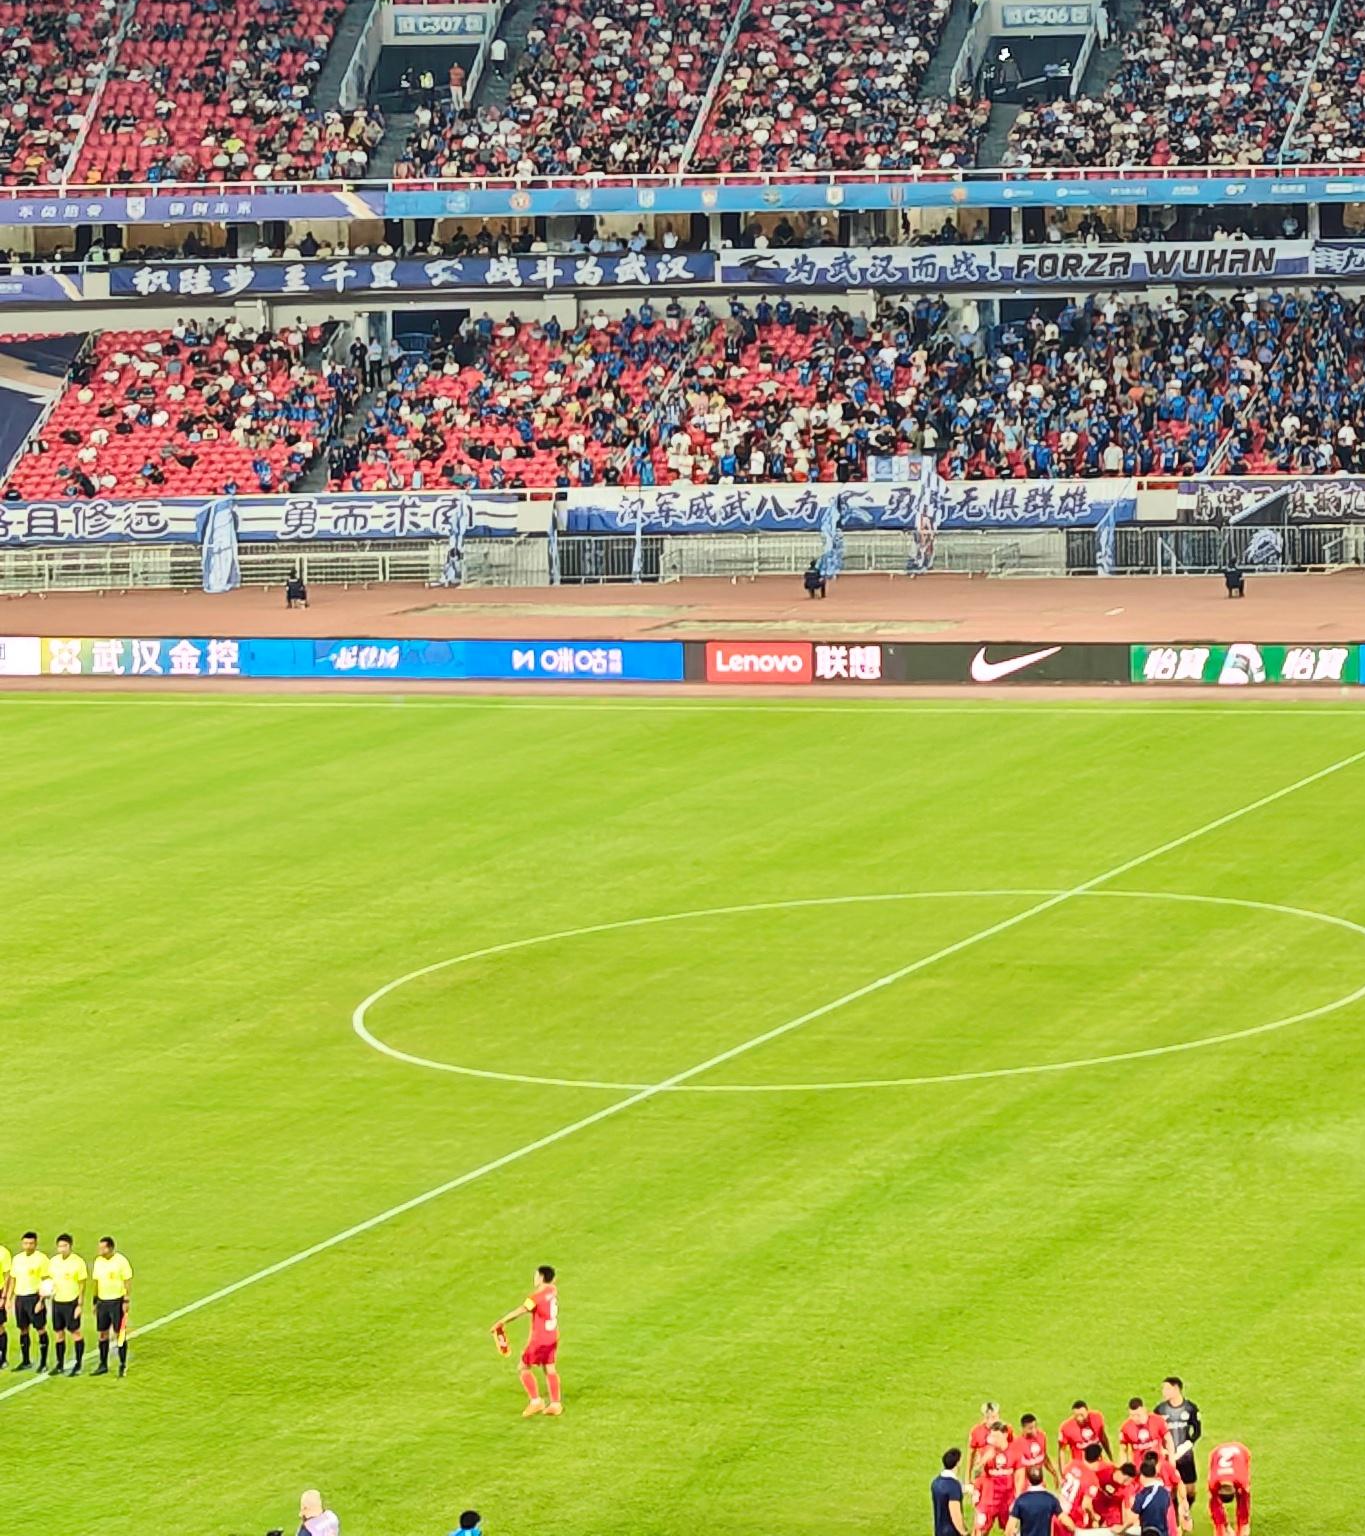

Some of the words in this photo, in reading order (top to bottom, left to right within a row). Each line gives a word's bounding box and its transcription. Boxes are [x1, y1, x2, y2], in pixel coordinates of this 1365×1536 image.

[418, 15, 464, 33] C307
[132, 263, 256, 297] 积跬步
[282, 260, 398, 293] 至千里
[485, 251, 695, 289] 战斗为武汉
[1016, 249, 1133, 280] FORZA
[1145, 246, 1278, 277] WUHAN
[92, 639, 241, 675] 武汉金控
[716, 650, 803, 673] Lenovo
[815, 644, 882, 680] 联想
